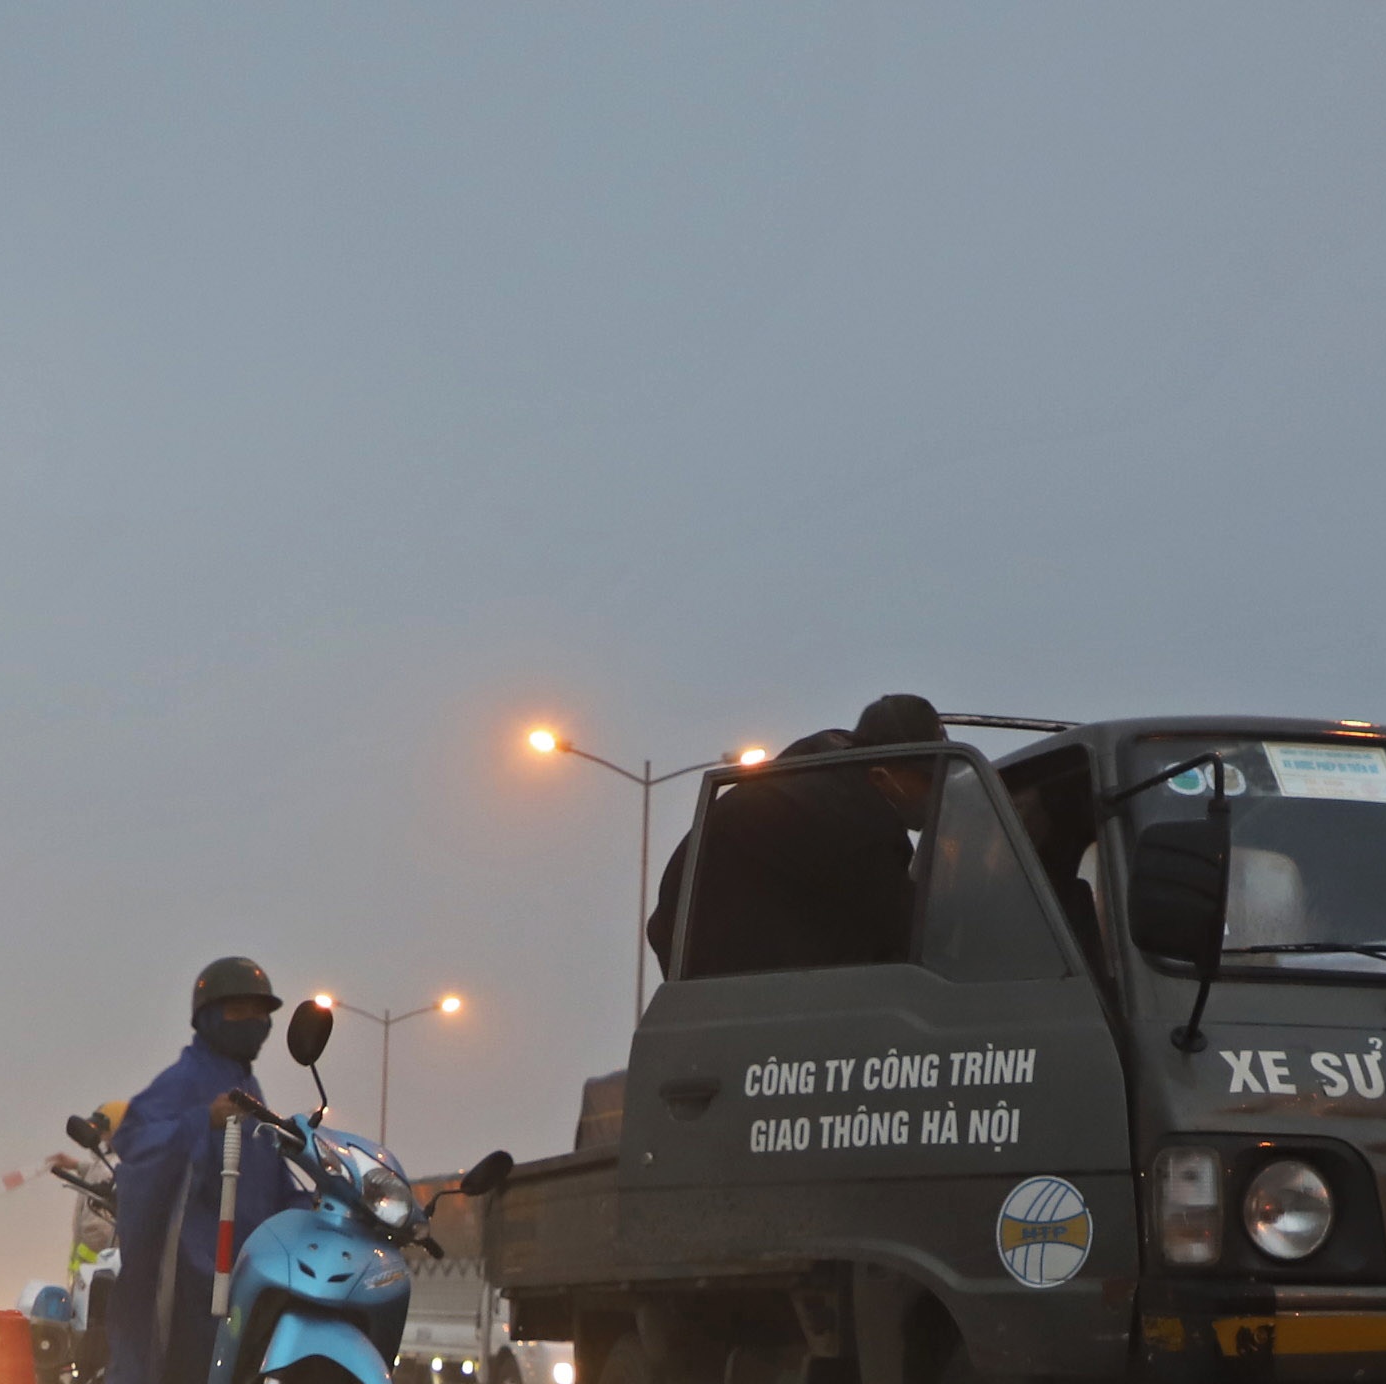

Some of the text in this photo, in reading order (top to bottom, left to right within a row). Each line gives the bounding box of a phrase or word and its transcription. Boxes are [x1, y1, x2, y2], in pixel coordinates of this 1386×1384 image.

[744, 1043, 1036, 1097] CÔNG TY CÔNG TRÌNH
[1219, 1050, 1297, 1095] XE
[750, 1100, 1021, 1153] GIAO THÔNG HÀ NỘI
[1021, 1226, 1069, 1240] HTP
